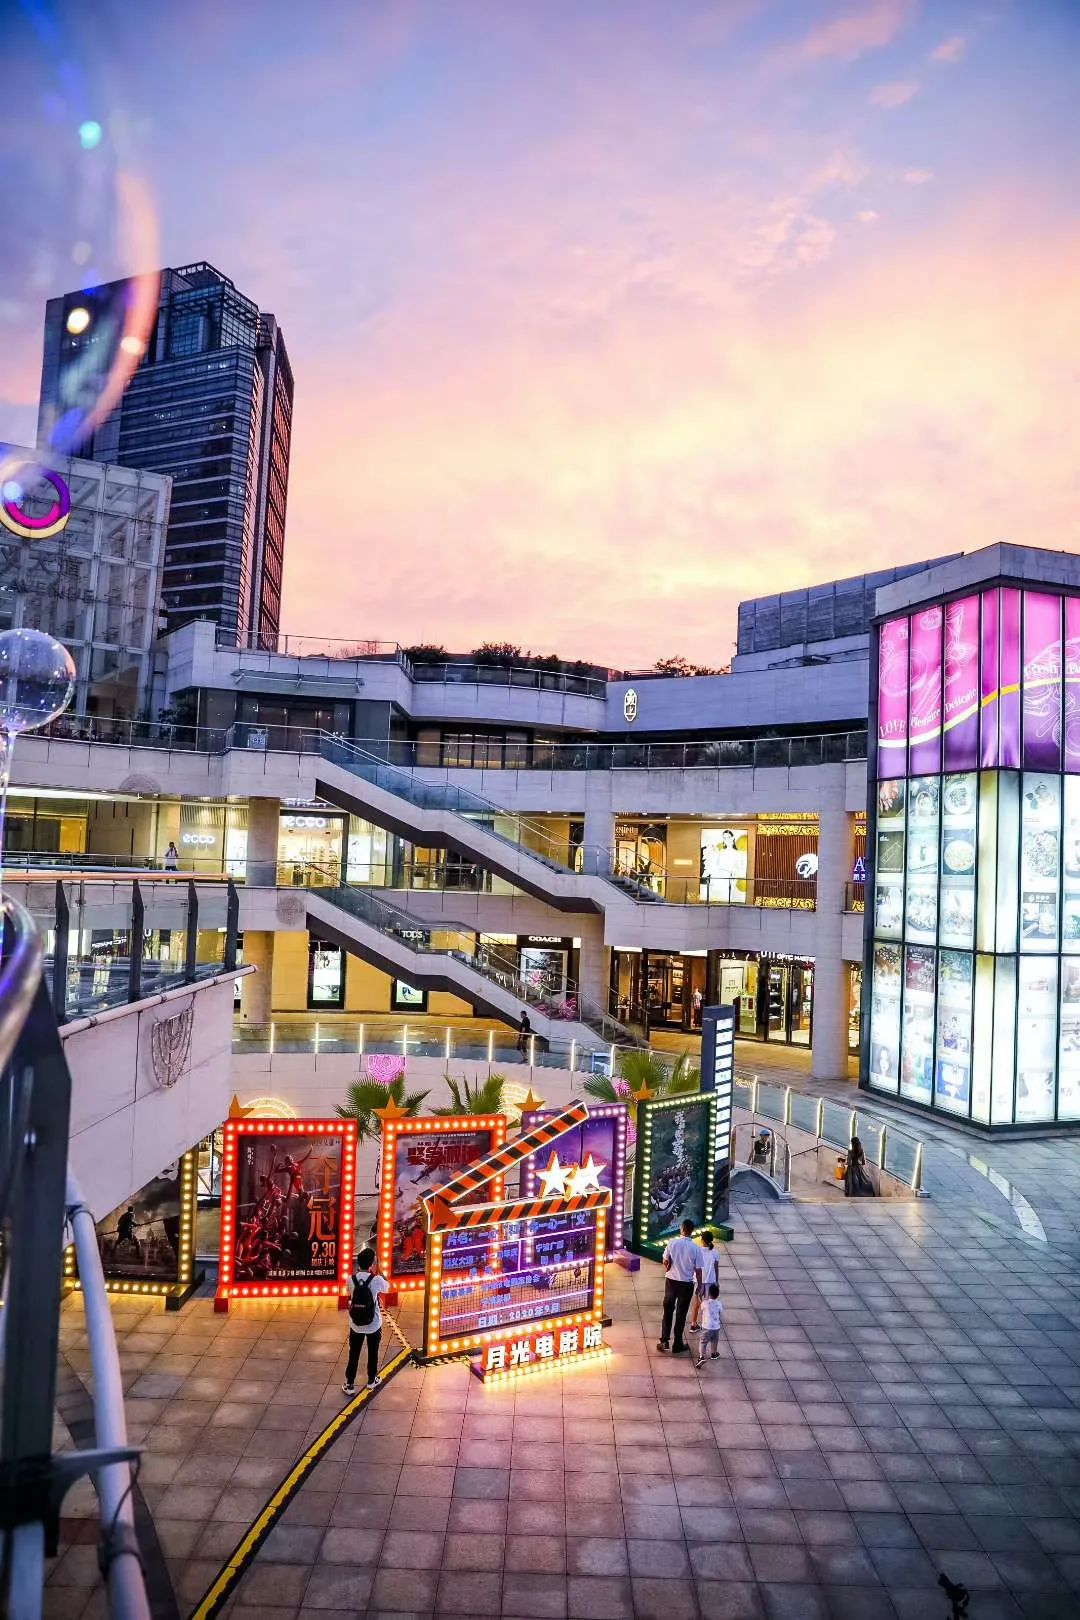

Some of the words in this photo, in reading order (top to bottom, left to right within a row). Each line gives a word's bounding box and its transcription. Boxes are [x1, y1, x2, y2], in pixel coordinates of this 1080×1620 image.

[880, 720, 905, 737] LOVE
[283, 816, 326, 828] ecco
[182, 833, 215, 845] ecco
[528, 935, 562, 943] COACH
[311, 1241, 336, 1257] 9.30
[485, 1322, 602, 1369] 月光电影院
